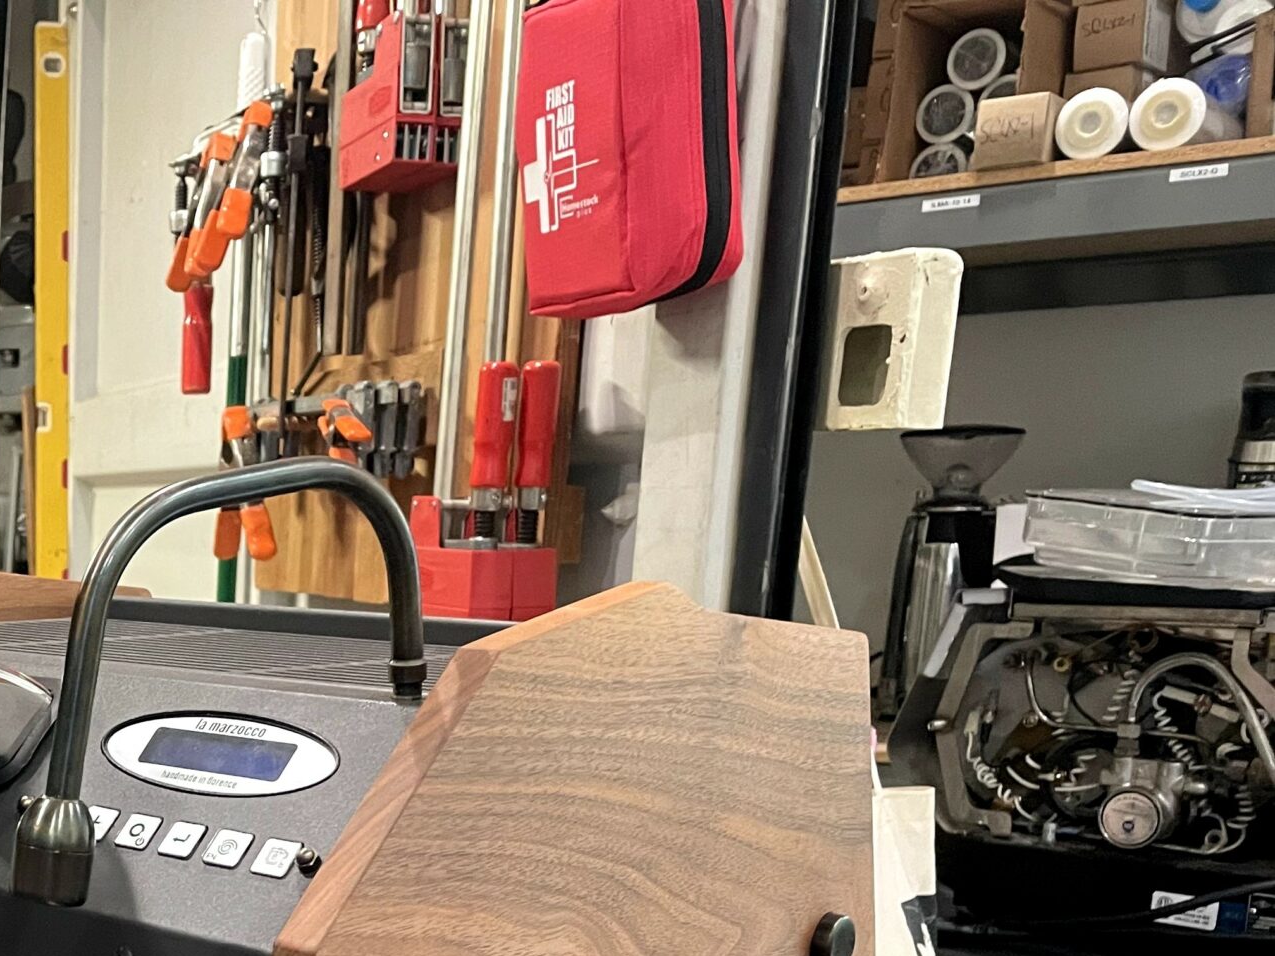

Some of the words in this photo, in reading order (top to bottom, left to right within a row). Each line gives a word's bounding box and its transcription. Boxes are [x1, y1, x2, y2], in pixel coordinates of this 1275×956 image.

[546, 80, 575, 112] FIRST
[557, 103, 575, 130] AID
[558, 125, 575, 151] KIT
[195, 718, 207, 730] la
[208, 722, 267, 738] marzocco
[161, 769, 198, 783] handmade
